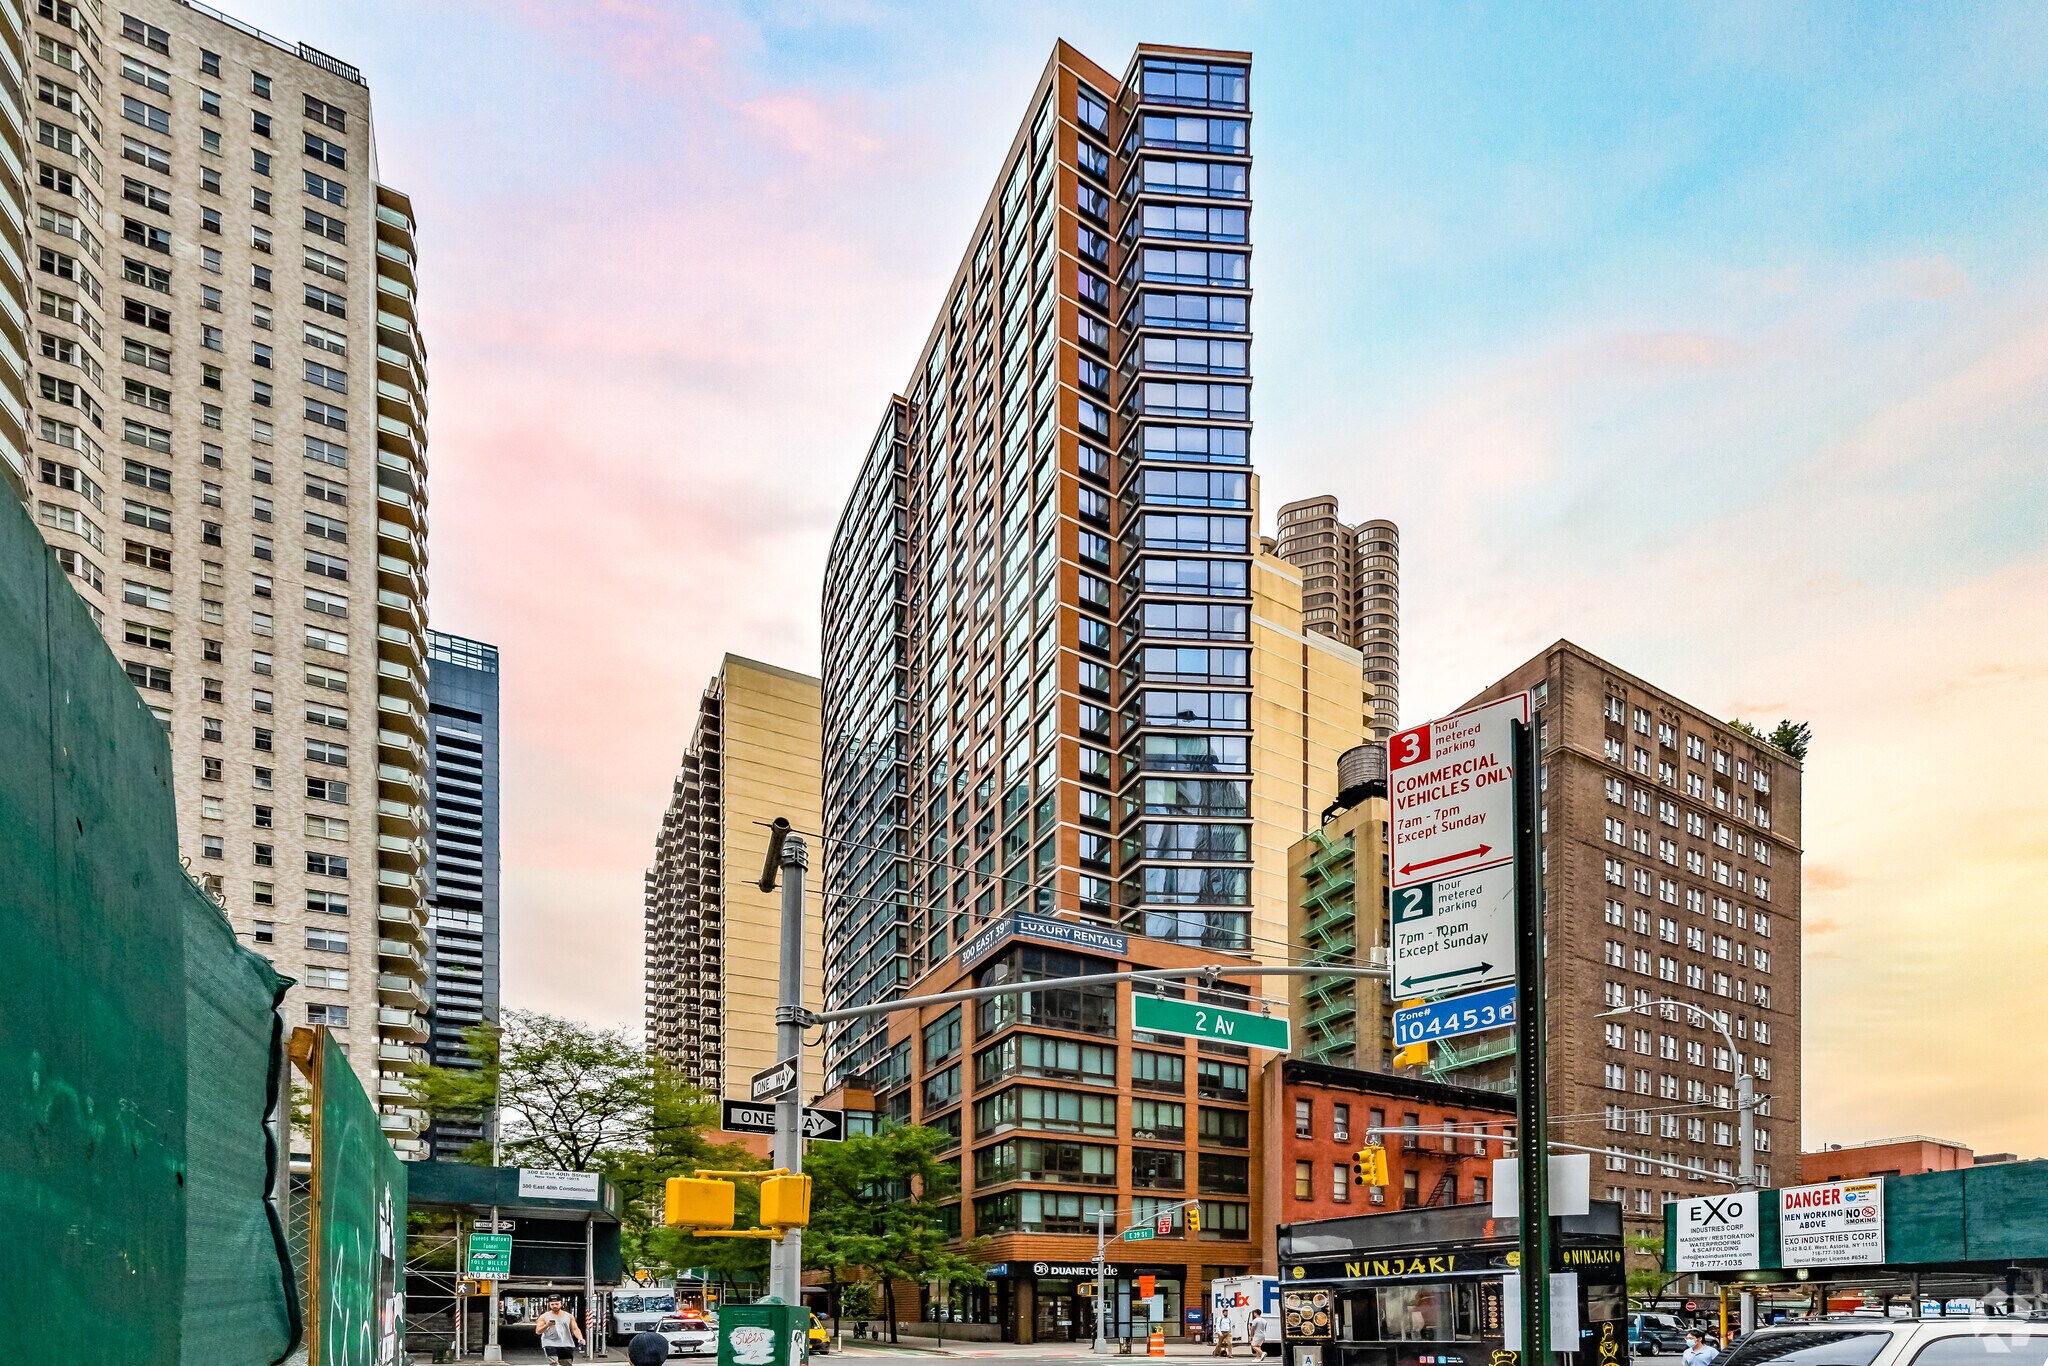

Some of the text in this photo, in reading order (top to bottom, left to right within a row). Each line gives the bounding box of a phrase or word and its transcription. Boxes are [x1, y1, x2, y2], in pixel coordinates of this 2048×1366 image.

[1436, 720, 1459, 734] hour
[1436, 723, 1481, 745] metered
[1400, 733, 1421, 763] 3
[1436, 738, 1476, 759] parking
[1397, 753, 1498, 794] COMMERCIAL
[1397, 778, 1470, 810] VEHICLES
[1398, 816, 1422, 830] 7am
[1434, 806, 1460, 820] 7pm
[1398, 813, 1486, 844] Except Sunday
[1438, 880, 1462, 892] hour
[1438, 885, 1482, 903] metered
[1402, 889, 1423, 919] 2
[1438, 900, 1477, 916] parking
[1021, 920, 1122, 948] LUXURY RENTALS
[1400, 932, 1424, 945] 7pm
[963, 946, 975, 962] 300
[976, 930, 994, 952] EAST
[1400, 933, 1488, 958] Except Sunday
[1195, 1011, 1235, 1036] 2 Av
[1400, 1008, 1431, 1021] Zone#
[1400, 1006, 1496, 1041] 104453
[757, 1070, 791, 1093] ONE WAY
[741, 1111, 825, 1130] ONE AY
[1786, 1189, 1840, 1209] DANGER
[1691, 1197, 1743, 1226] EXO
[1804, 1209, 1842, 1219] WORKING
[1846, 1209, 1860, 1218] NO
[1800, 1220, 1826, 1229] ABOVE
[1802, 1234, 1849, 1243] INDUSTRIES
[1852, 1232, 1878, 1241] CORP.
[1345, 1255, 1455, 1278] NINJAKI
[1572, 1250, 1613, 1265] NINJAKI
[1215, 1292, 1250, 1308] FedEx
